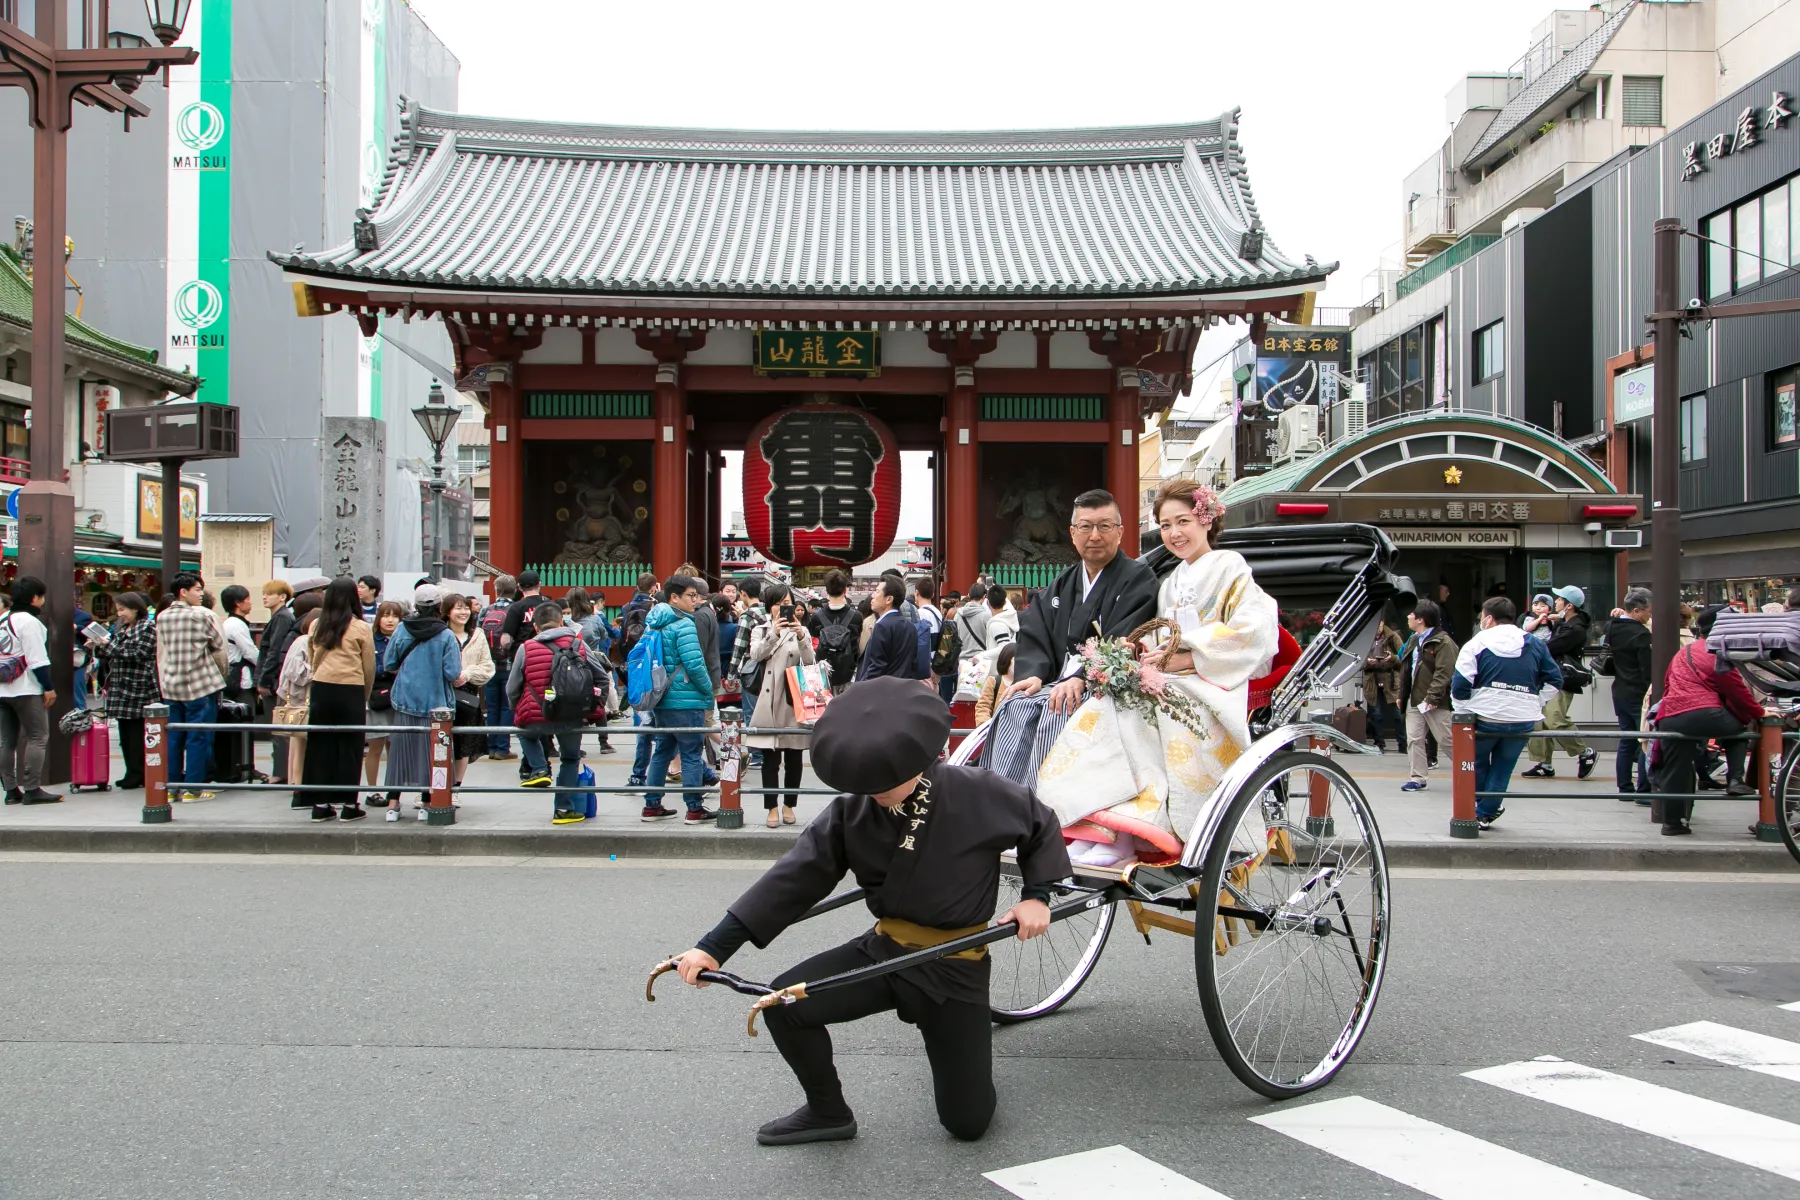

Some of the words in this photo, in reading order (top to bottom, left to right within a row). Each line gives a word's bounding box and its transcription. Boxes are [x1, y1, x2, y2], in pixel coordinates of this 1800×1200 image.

[1681, 91, 1800, 182] 黒田屋本
[173, 156, 226, 168] MATSUI
[171, 334, 224, 346] MATSUI
[1264, 337, 1339, 352] 日本宝石館
[760, 410, 886, 564] 雷門
[1379, 508, 1442, 519] 浅草警察署
[1446, 501, 1530, 520] 雷門交番
[1386, 532, 1462, 543] AMINARIMON
[1468, 532, 1509, 543] KOBAN
[900, 788, 931, 851] えびす屋
